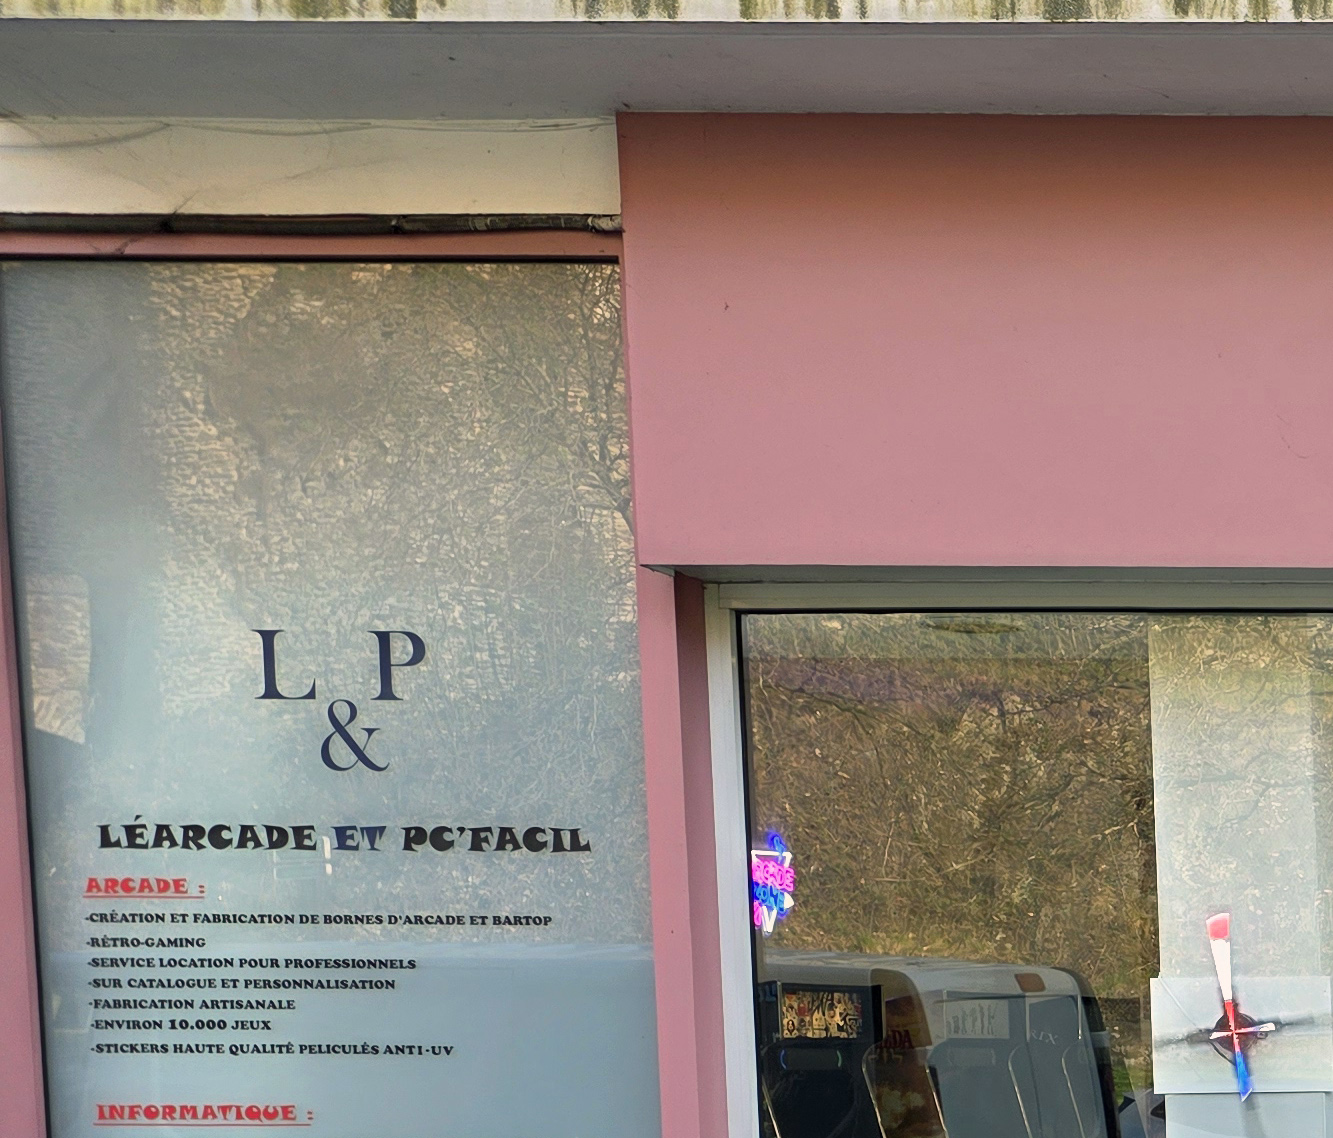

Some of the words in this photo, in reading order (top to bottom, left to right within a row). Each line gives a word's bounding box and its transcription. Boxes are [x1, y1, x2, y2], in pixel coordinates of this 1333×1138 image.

[253, 629, 317, 701] L
[369, 629, 427, 702] P
[319, 698, 390, 773] &
[97, 815, 318, 851] LÉARCADE
[332, 824, 388, 852] ET
[401, 824, 592, 853] PC'FACIL
[85, 877, 189, 894] ARCADE
[170, 913, 189, 923] ET
[193, 913, 295, 924] FABRICATION
[299, 914, 320, 924] DE
[323, 915, 383, 925] BORNES
[388, 915, 465, 925] D'ARCADE
[469, 916, 488, 925] ET
[492, 916, 552, 926] BARTOP
[159, 958, 234, 968] LOCATION
[238, 958, 280, 968] POUR
[284, 959, 416, 969] PROFESSIONNELS
[127, 978, 217, 989] CATALOGUE
[220, 979, 240, 989] ET
[244, 979, 395, 989] PERSONNALISATION
[199, 1000, 296, 1010] ARTISANALE
[168, 1019, 227, 1030] 10.000
[231, 1020, 271, 1030] JEUX
[173, 1044, 225, 1054] HAUTE
[229, 1042, 295, 1056] QUALITÉ
[298, 1042, 379, 1055] PELICULÉS
[96, 1104, 297, 1123] INFORMATIQUE
